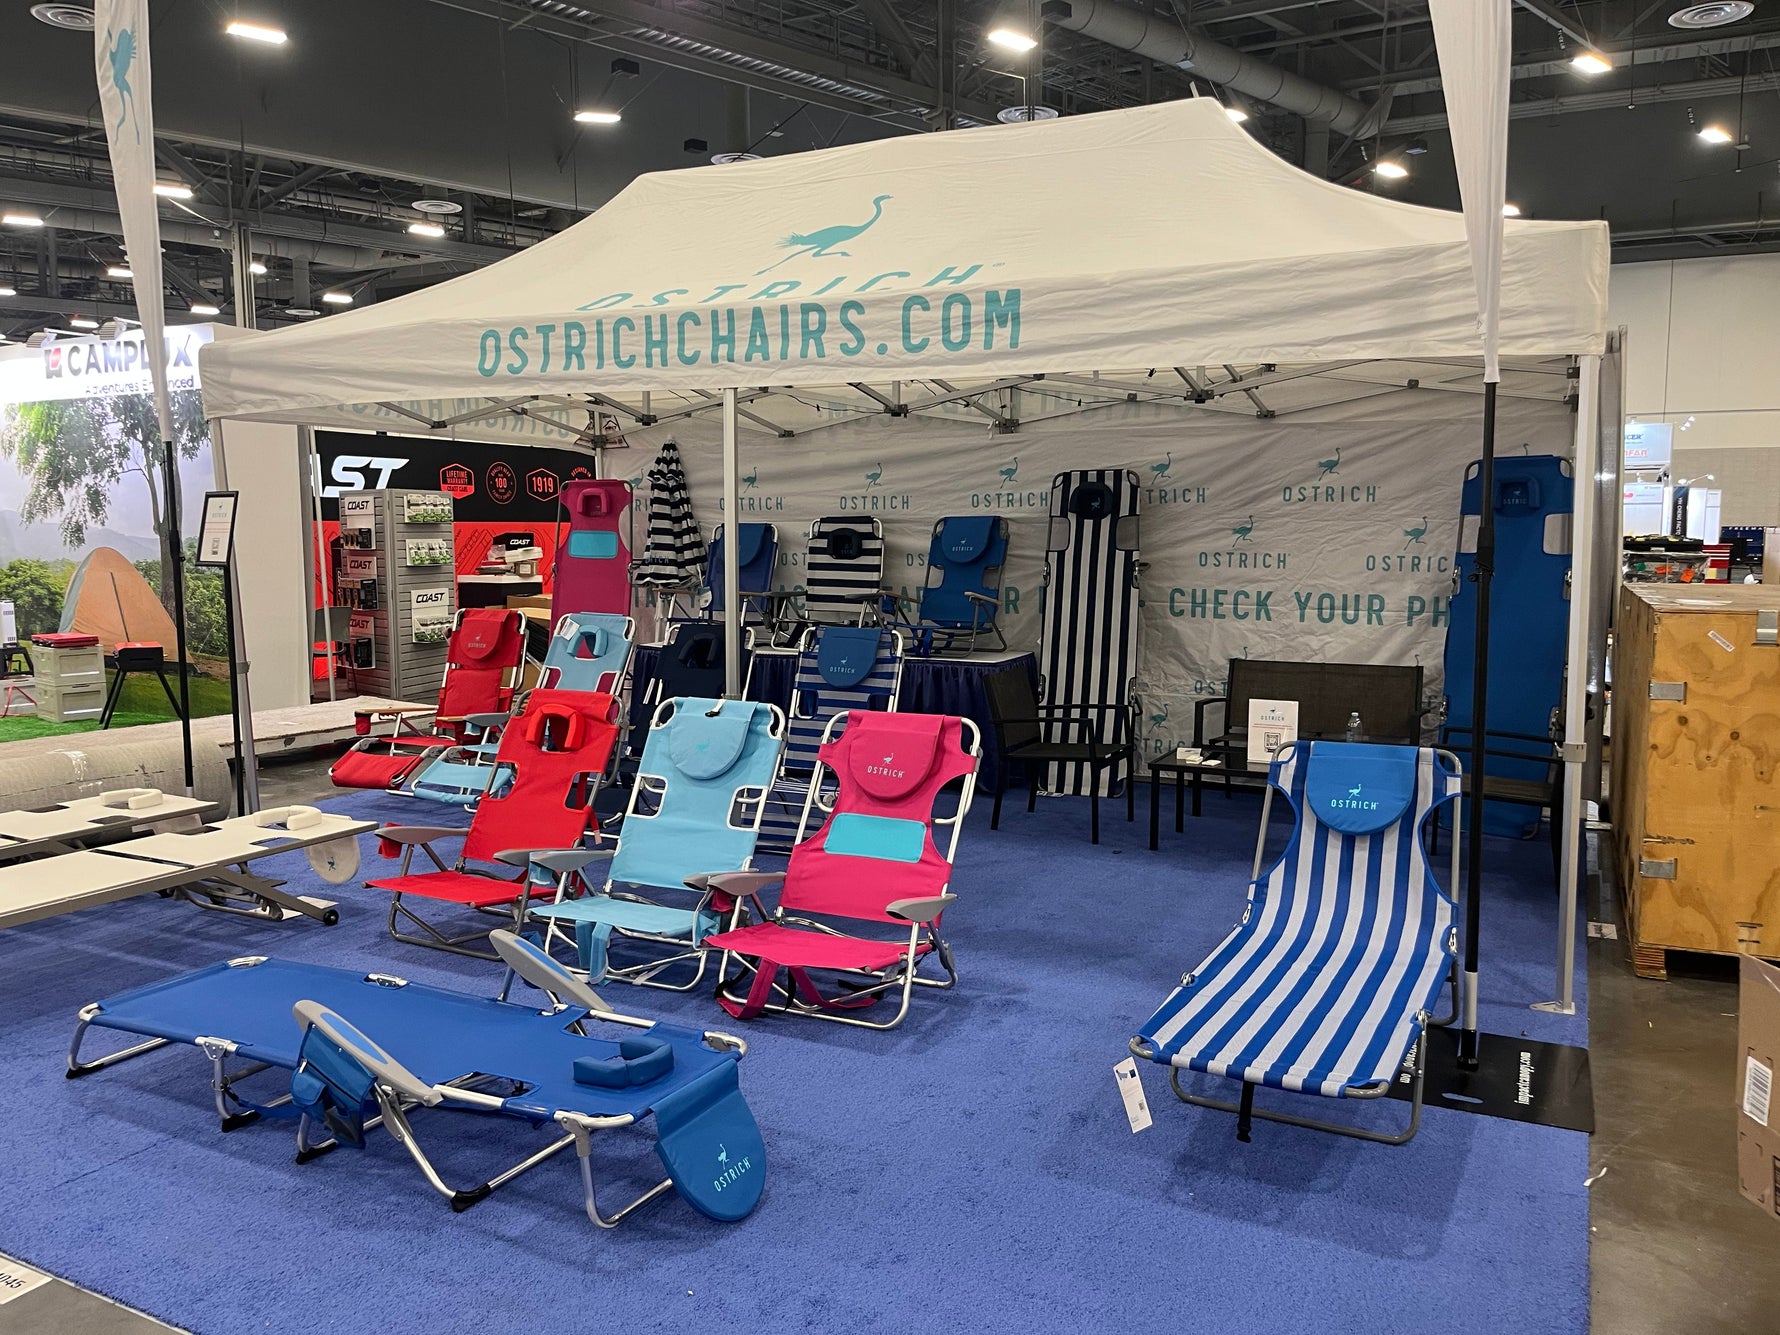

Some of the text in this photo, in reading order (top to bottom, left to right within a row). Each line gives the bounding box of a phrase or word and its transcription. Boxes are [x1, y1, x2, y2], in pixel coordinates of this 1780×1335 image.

[476, 288, 1022, 377] OSTRICHCHAIRS.COM
[495, 477, 508, 489] 100
[532, 476, 554, 493] 1919
[971, 491, 1049, 508] OSTRICH
[1145, 487, 1206, 504] TRICH
[1282, 485, 1378, 503] OSTRICH
[347, 500, 370, 510] COAST
[719, 496, 783, 511] OTRICH
[840, 495, 910, 511] OSTRICH
[509, 537, 531, 546] COAST
[350, 560, 373, 570] COAST
[1199, 551, 1288, 570] OSTRICH
[1365, 554, 1450, 573] OSTRIC
[415, 592, 446, 604] COAST
[1168, 587, 1274, 622] CHECK
[1294, 591, 1386, 626] YOUR
[829, 665, 856, 674] OSTRICH
[867, 764, 905, 780] OSTRICH
[1330, 797, 1379, 811] OSTRICH
[714, 1156, 752, 1192] OSTRICH
